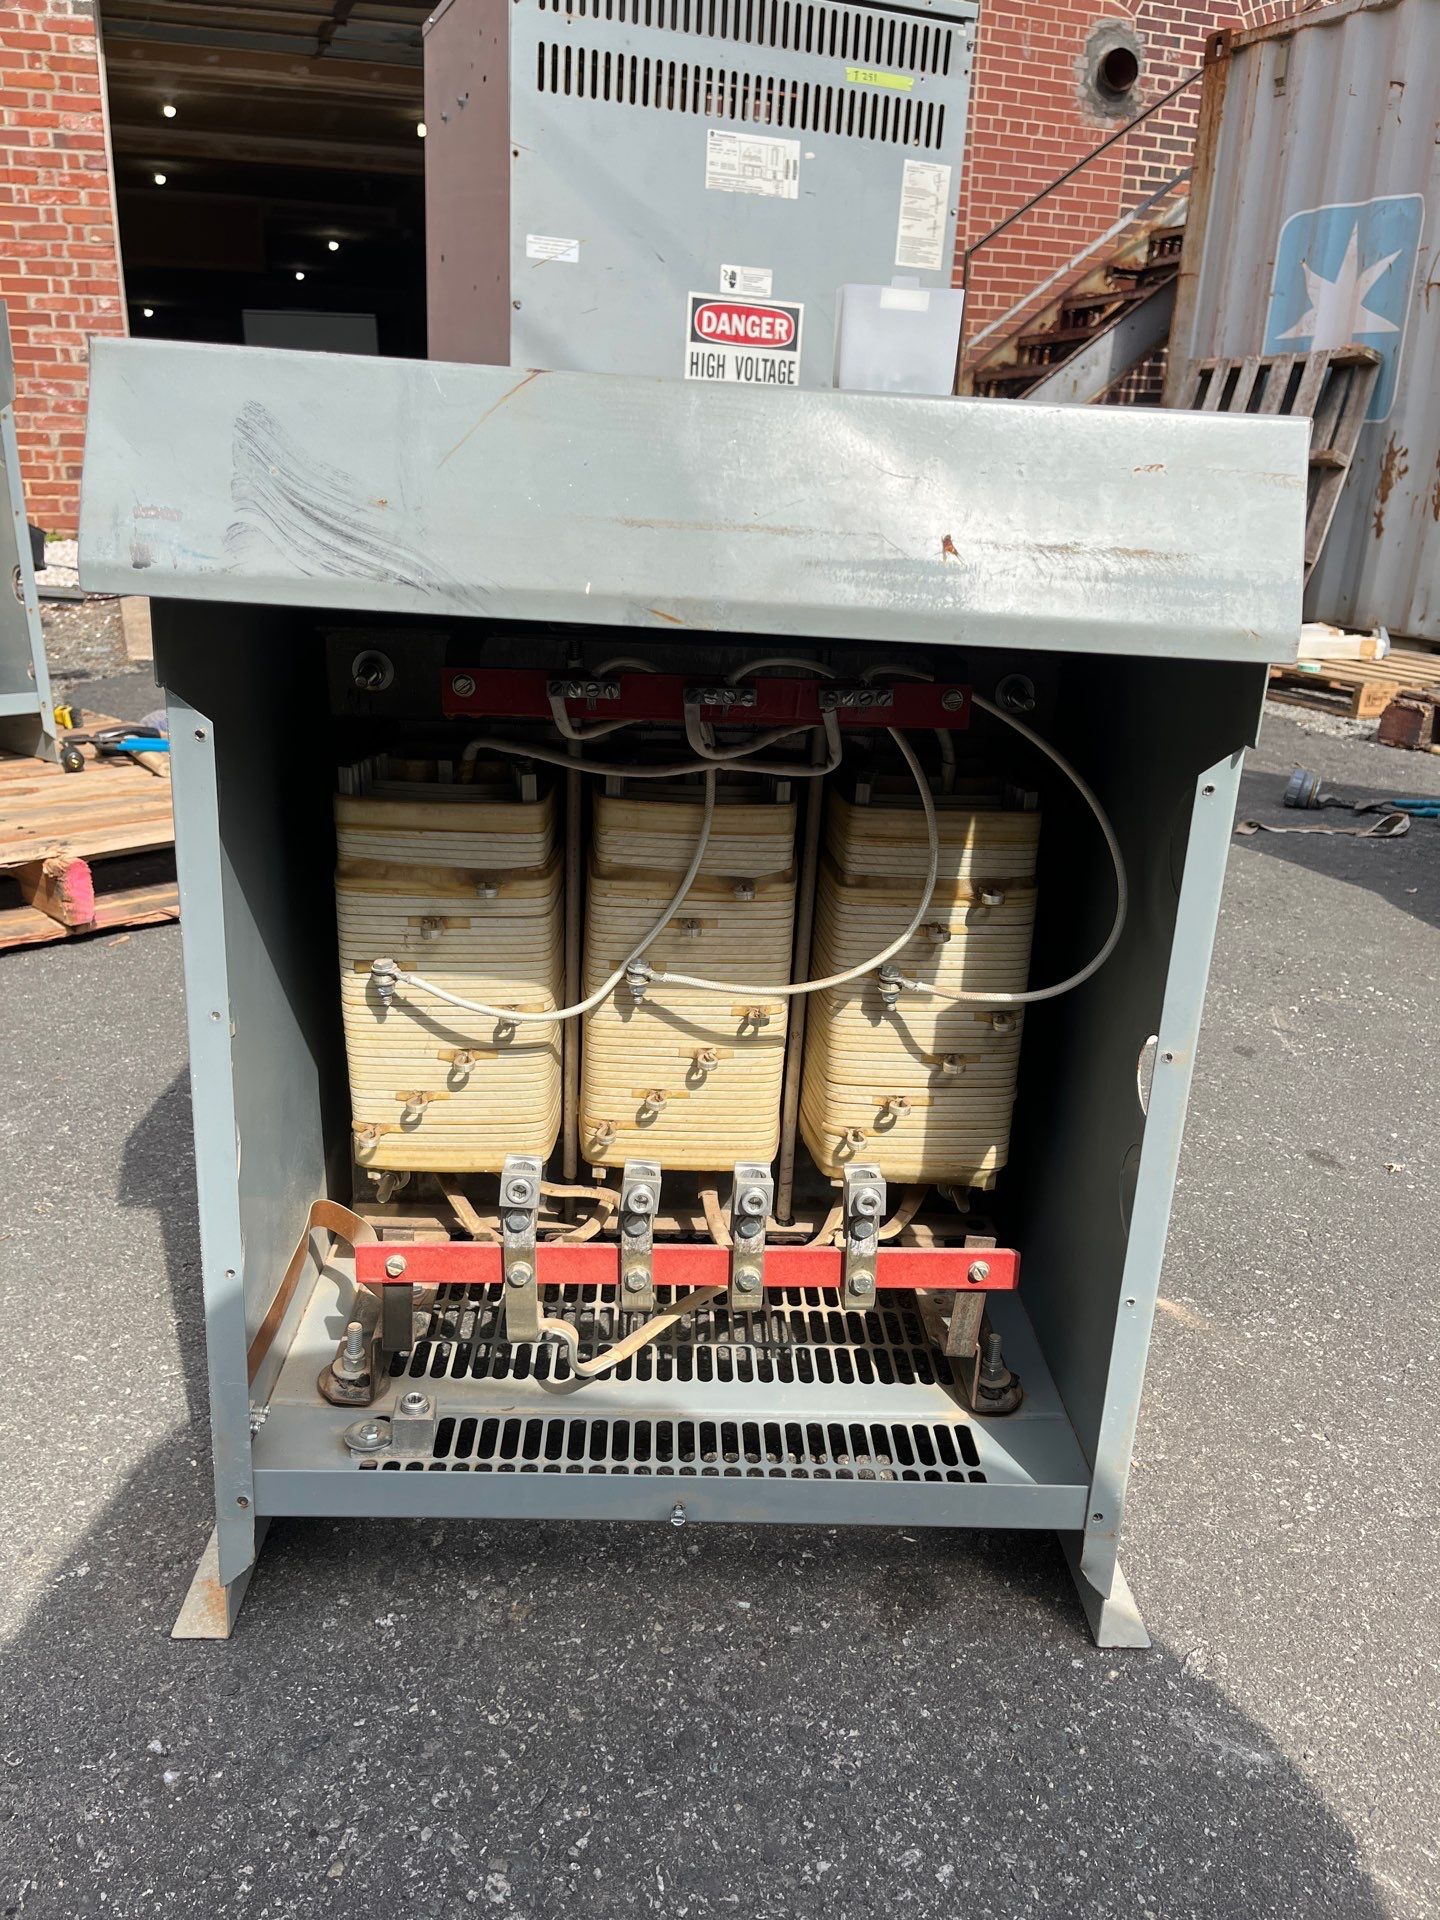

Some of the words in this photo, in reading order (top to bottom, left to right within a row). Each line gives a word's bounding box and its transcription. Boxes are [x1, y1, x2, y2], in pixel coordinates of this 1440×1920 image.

[701, 310, 789, 341] DANGER
[690, 351, 726, 379] HIGH
[735, 355, 796, 385] VOLTAGE
